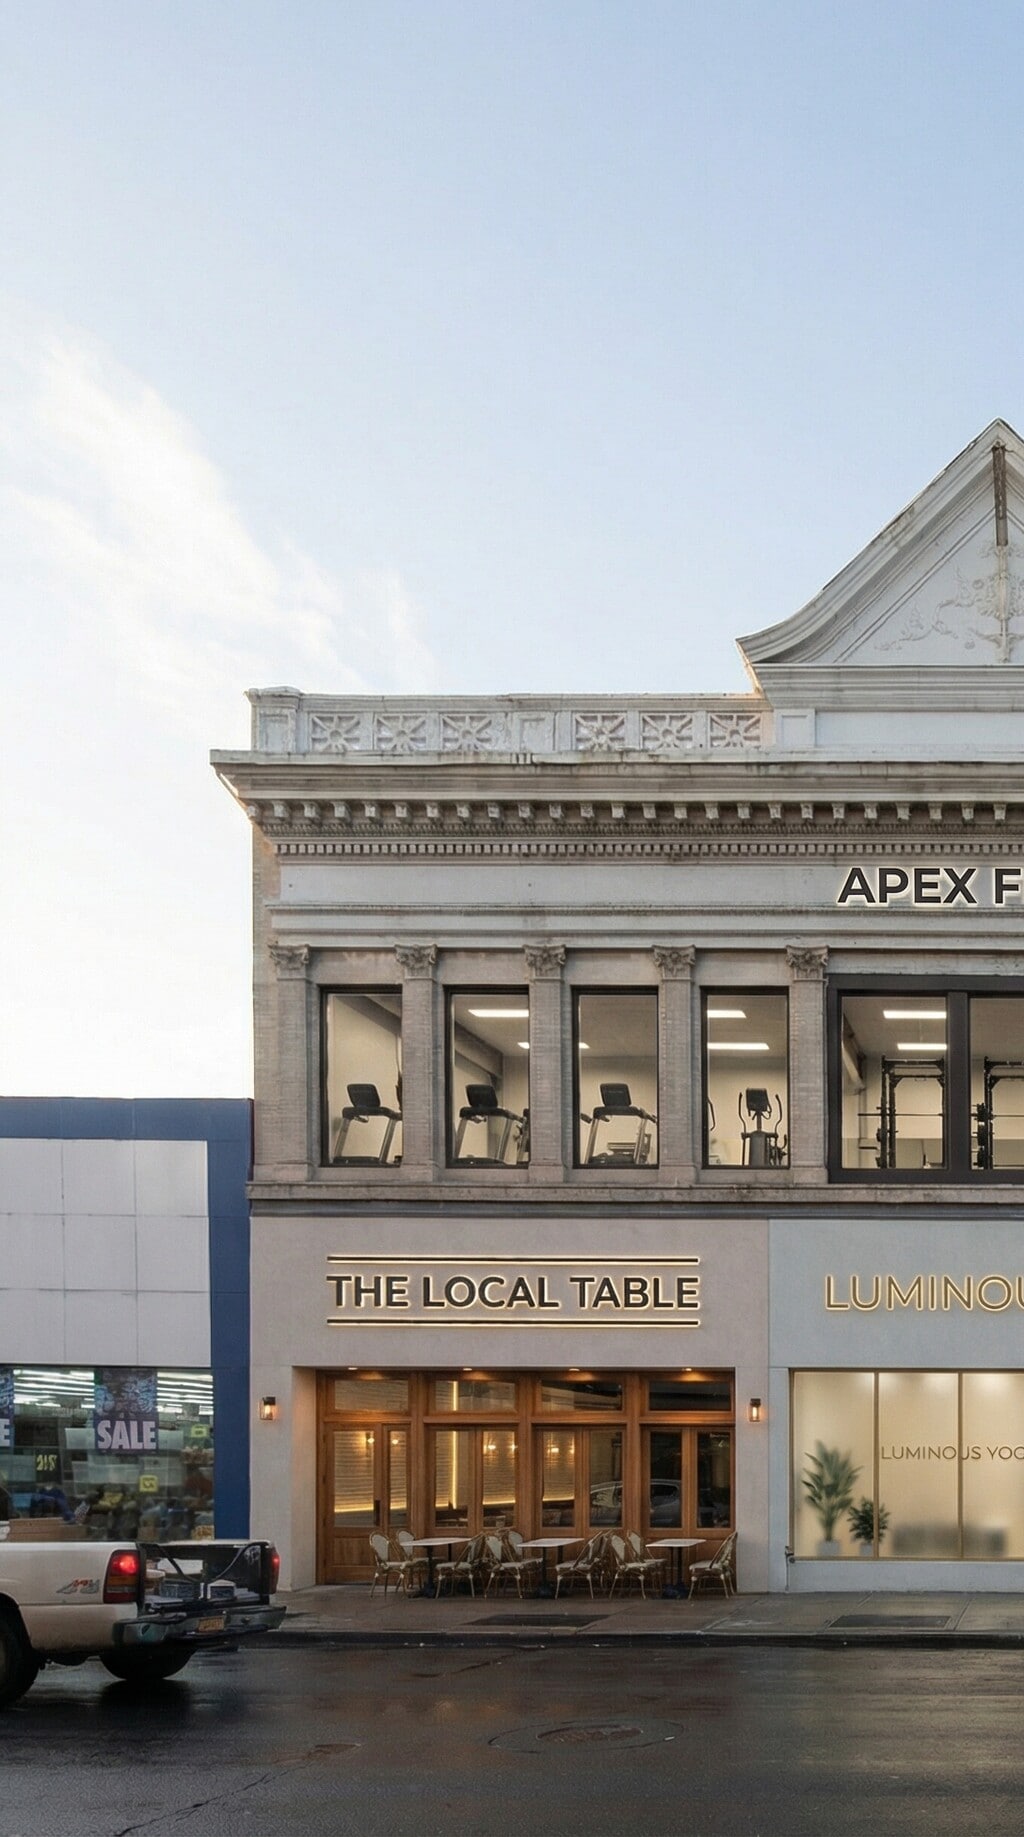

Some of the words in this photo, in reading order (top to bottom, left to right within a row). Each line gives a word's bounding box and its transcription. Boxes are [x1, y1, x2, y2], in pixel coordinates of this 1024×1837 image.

[837, 867, 978, 904] APEX
[326, 1275, 409, 1308] THE
[422, 1276, 560, 1309] LOCAL
[569, 1276, 700, 1309] TABLE
[97, 1420, 157, 1449] SALE
[881, 1445, 982, 1461] LUMINOUS
